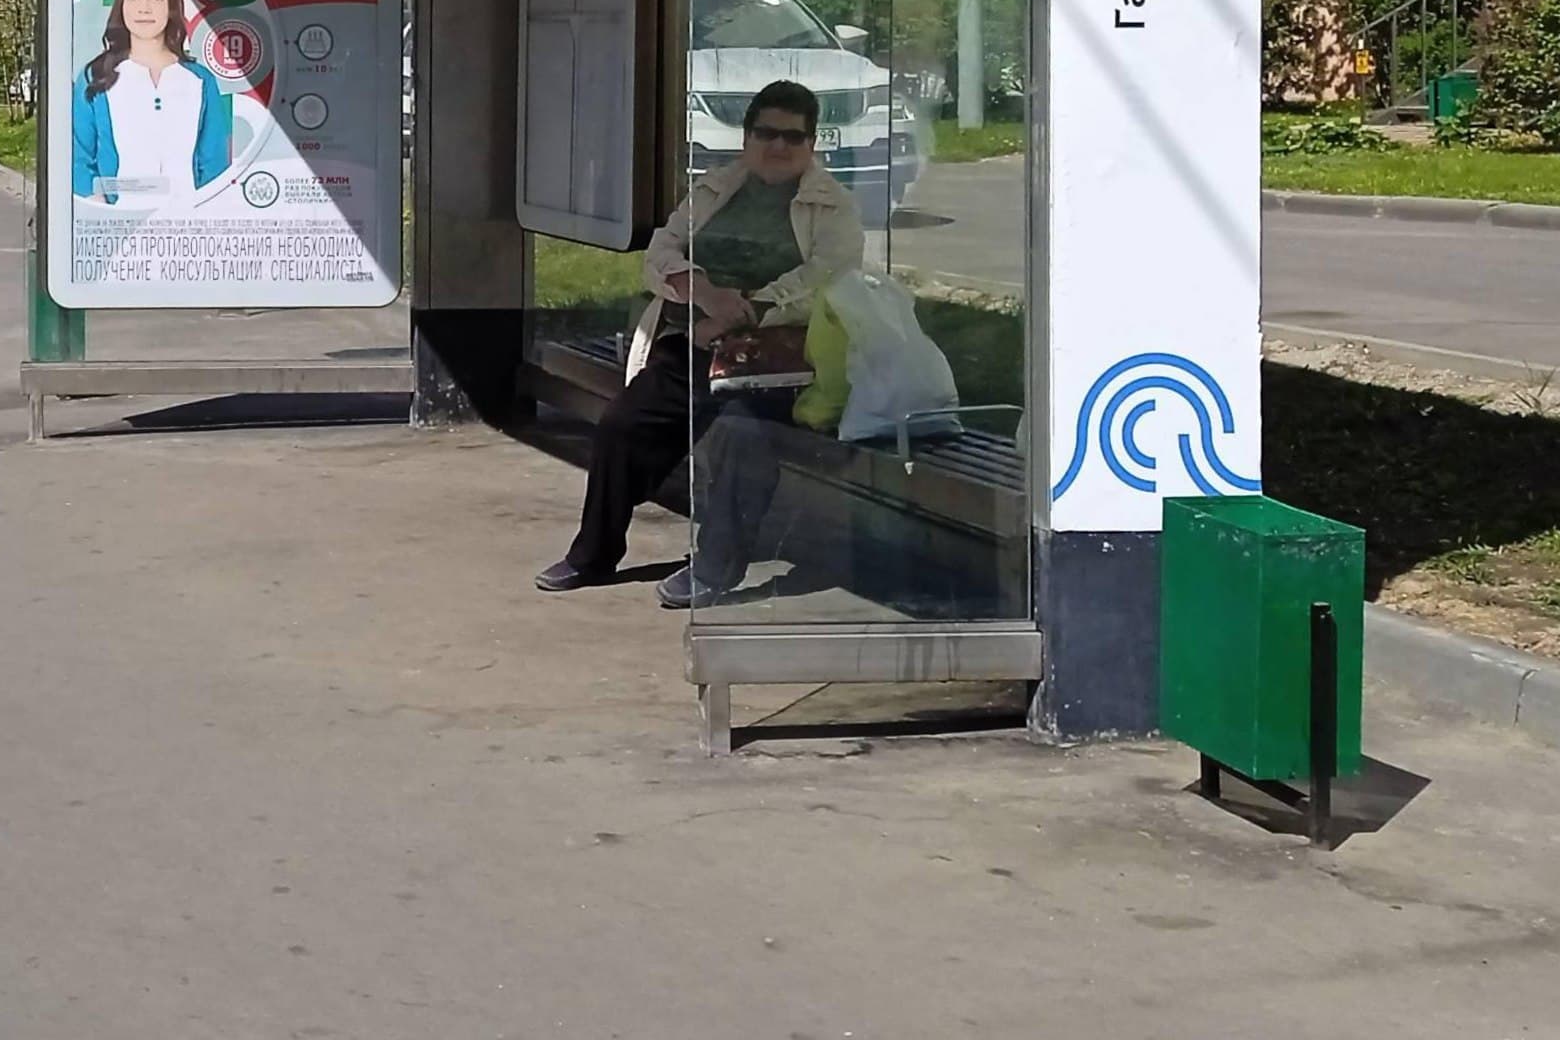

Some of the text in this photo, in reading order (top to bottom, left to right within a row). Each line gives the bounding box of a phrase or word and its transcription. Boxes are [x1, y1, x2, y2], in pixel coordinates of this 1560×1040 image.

[222, 35, 243, 58] 19
[326, 176, 350, 185] МЛН
[75, 235, 364, 258] ИМЕЮТСЯ ПРОТИВОПОКАЗАНИЯ НЕОБХОДИМО
[75, 259, 151, 283] ПОЛУЧЕНИЕ
[160, 259, 263, 283] КОНСУЛЬТАЦИИ
[270, 259, 363, 283] СПЕЦИАЛИСТА
